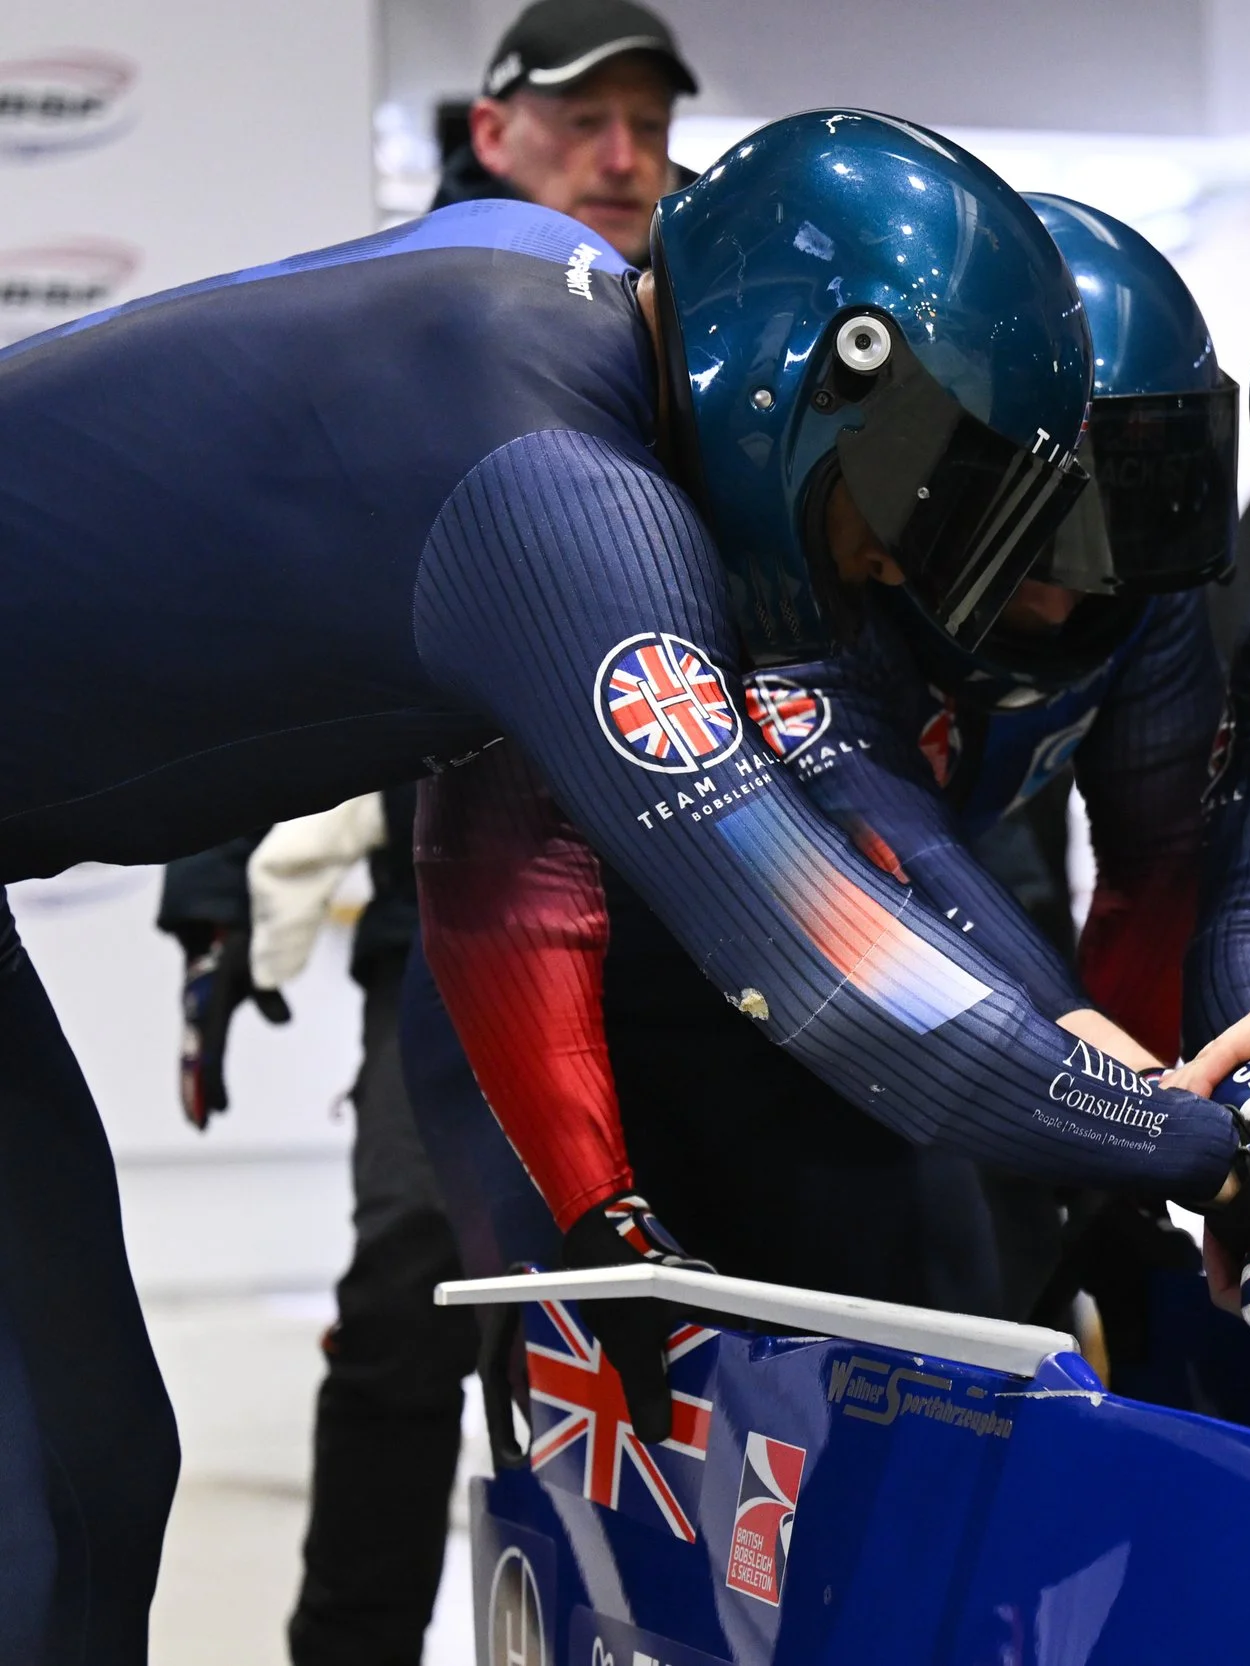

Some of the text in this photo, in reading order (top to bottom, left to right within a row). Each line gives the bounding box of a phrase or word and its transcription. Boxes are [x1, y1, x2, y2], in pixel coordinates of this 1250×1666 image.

[637, 776, 717, 830] TEAM
[691, 773, 773, 822] BOBSLEIGH
[1062, 1039, 1153, 1097] Altus
[1049, 1071, 1169, 1138] Consulting
[1032, 1108, 1063, 1130] People
[1068, 1122, 1101, 1142] Passion
[1108, 1134, 1157, 1154] Partnership
[828, 1356, 1014, 1439] Wallner Sportfahrzeugbau
[733, 1544, 773, 1574] BOBSLEIGH
[736, 1527, 764, 1551] BRITISH
[731, 1562, 773, 1592] & SKELETON
